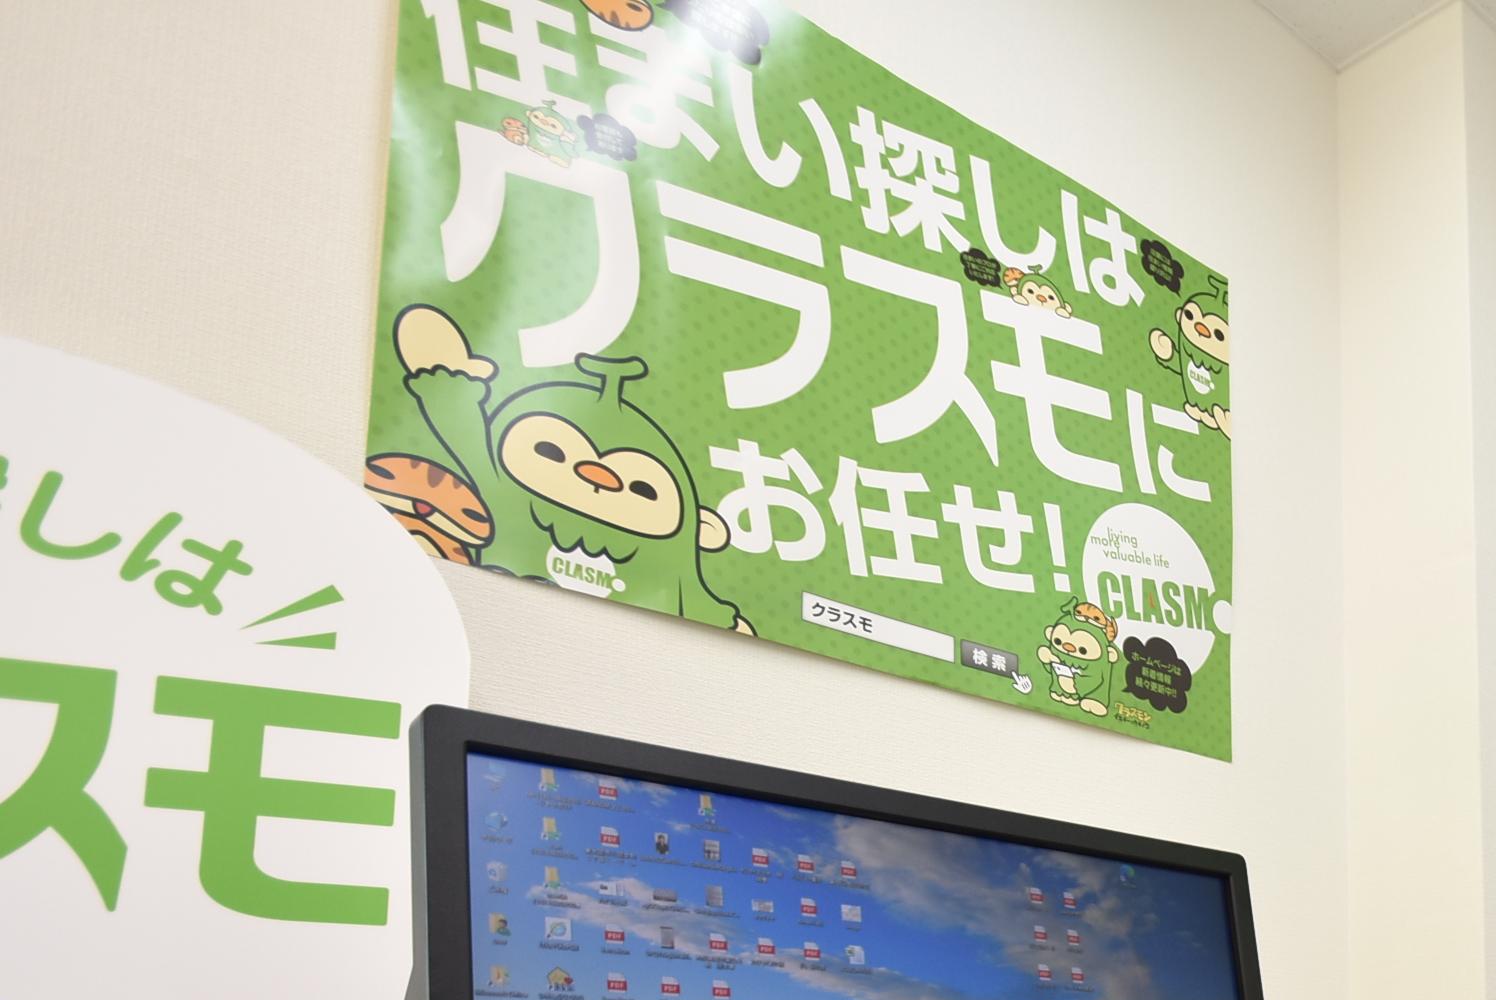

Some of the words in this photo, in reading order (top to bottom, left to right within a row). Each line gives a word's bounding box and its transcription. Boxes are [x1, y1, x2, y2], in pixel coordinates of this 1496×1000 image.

[440, 120, 1211, 502] クラスモに
[0, 455, 253, 616] しは
[1107, 527, 1137, 548] living
[1103, 546, 1151, 565] valuable
[1154, 554, 1170, 568] life
[812, 602, 873, 634] クラスモ
[972, 648, 1007, 672] 検索
[0, 657, 402, 926] スモ
